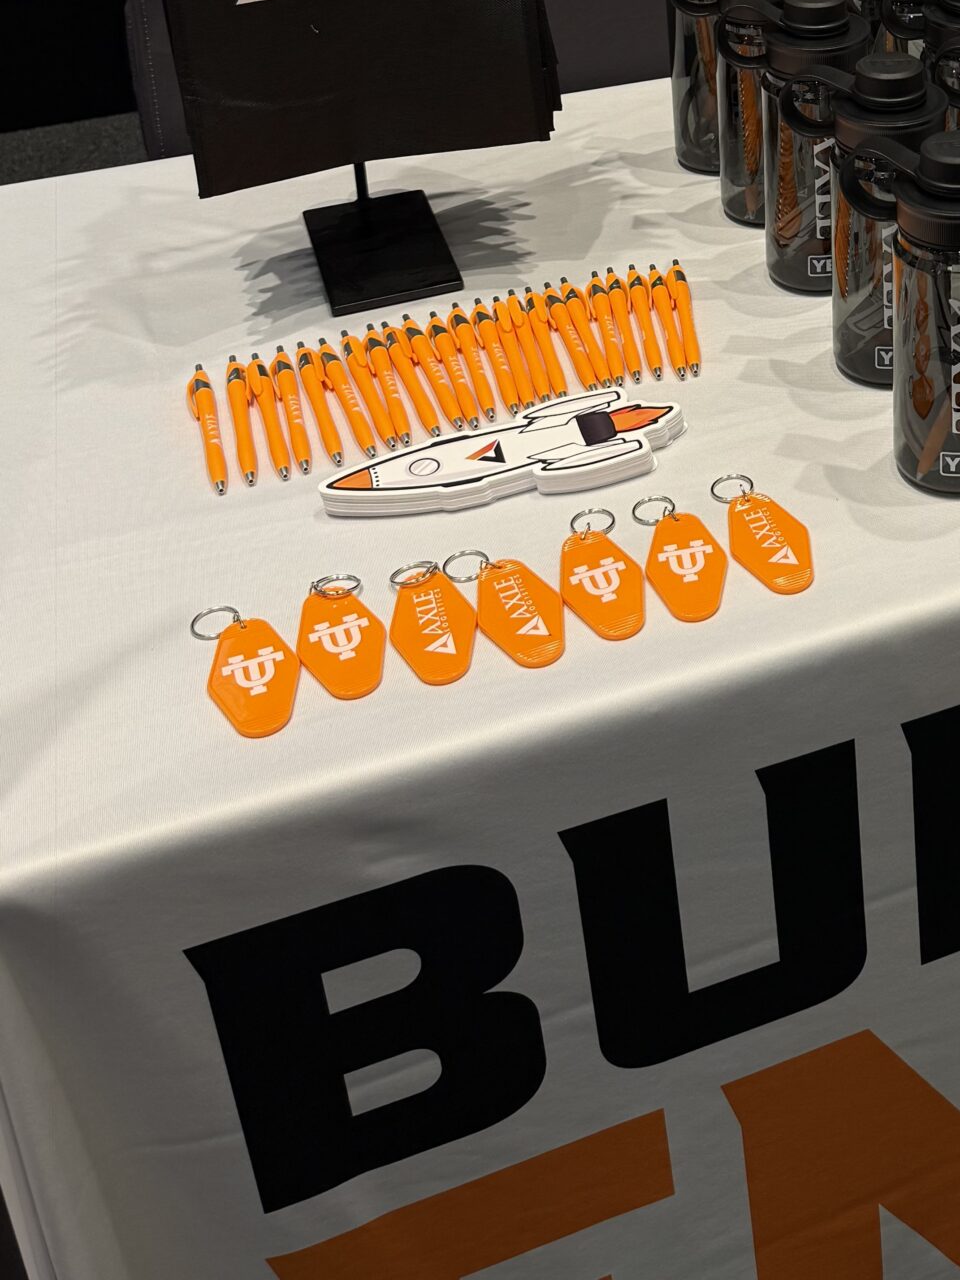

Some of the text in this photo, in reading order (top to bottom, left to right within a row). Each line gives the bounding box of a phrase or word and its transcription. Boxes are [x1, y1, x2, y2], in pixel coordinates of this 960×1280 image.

[744, 508, 782, 547] AXLE
[412, 590, 443, 634] AXLE
[494, 576, 532, 618] AXLE
